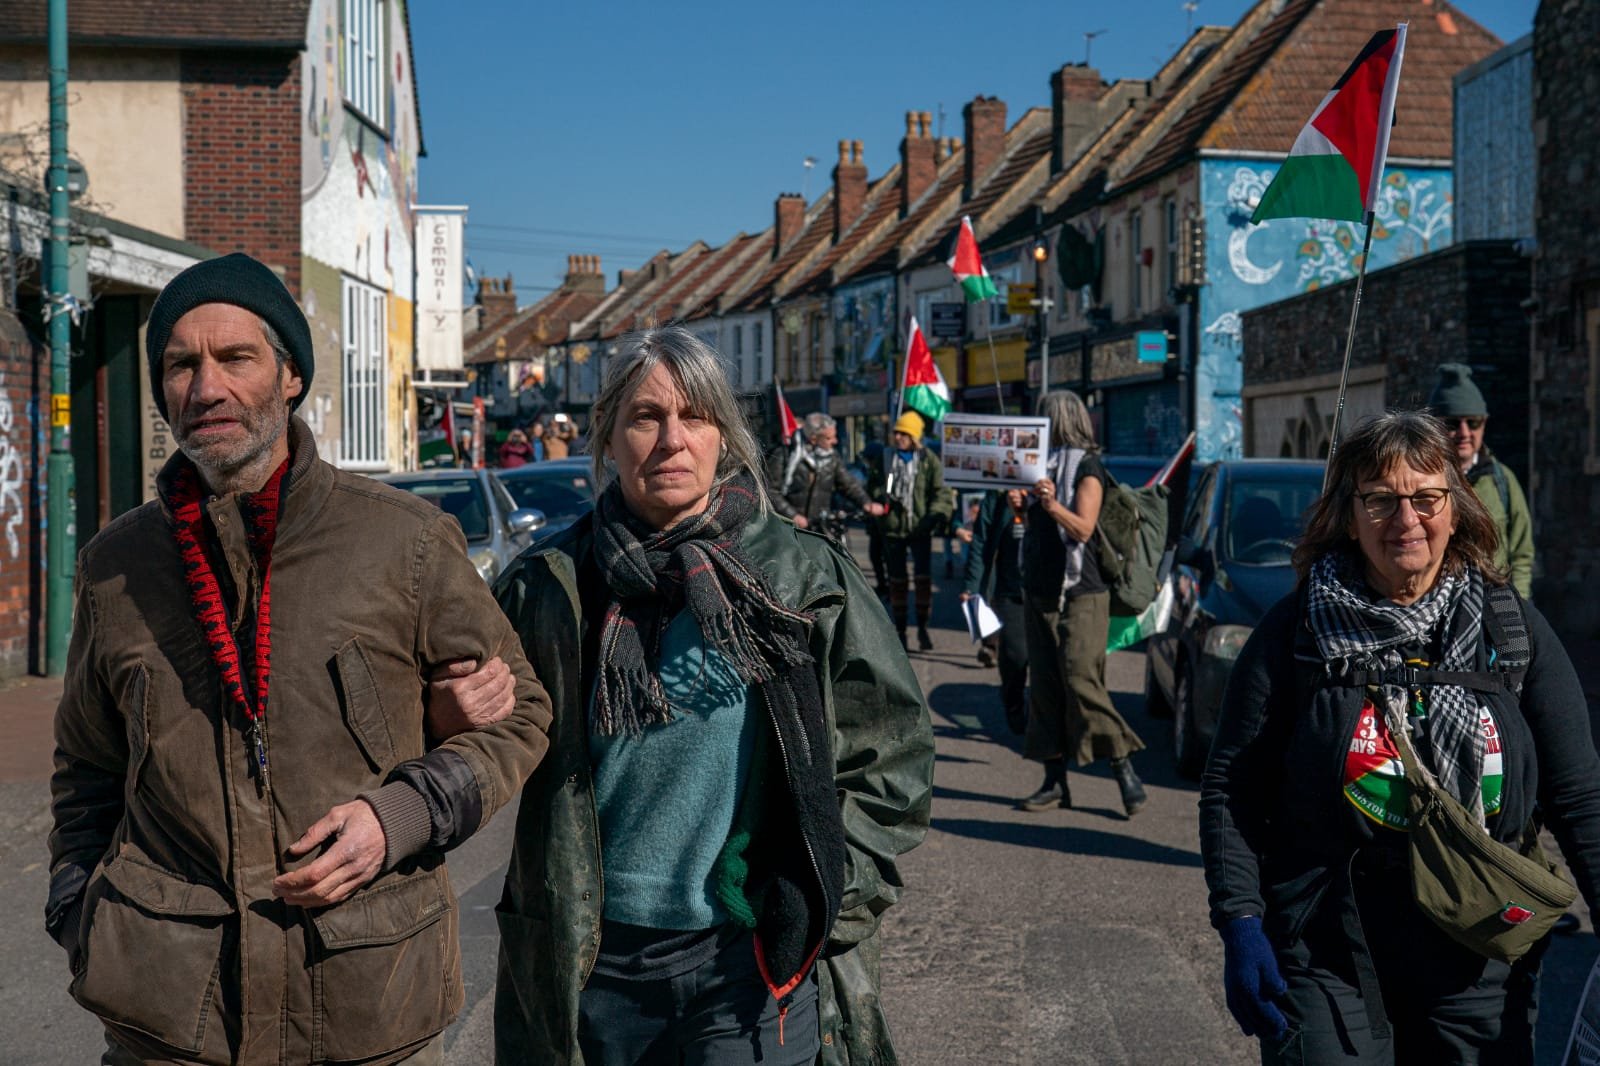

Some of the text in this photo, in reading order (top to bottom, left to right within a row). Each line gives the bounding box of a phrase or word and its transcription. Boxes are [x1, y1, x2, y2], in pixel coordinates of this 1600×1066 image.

[1349, 737, 1376, 755] AYS
[1348, 782, 1385, 818] BRISTOL
[1387, 812, 1401, 825] TO
